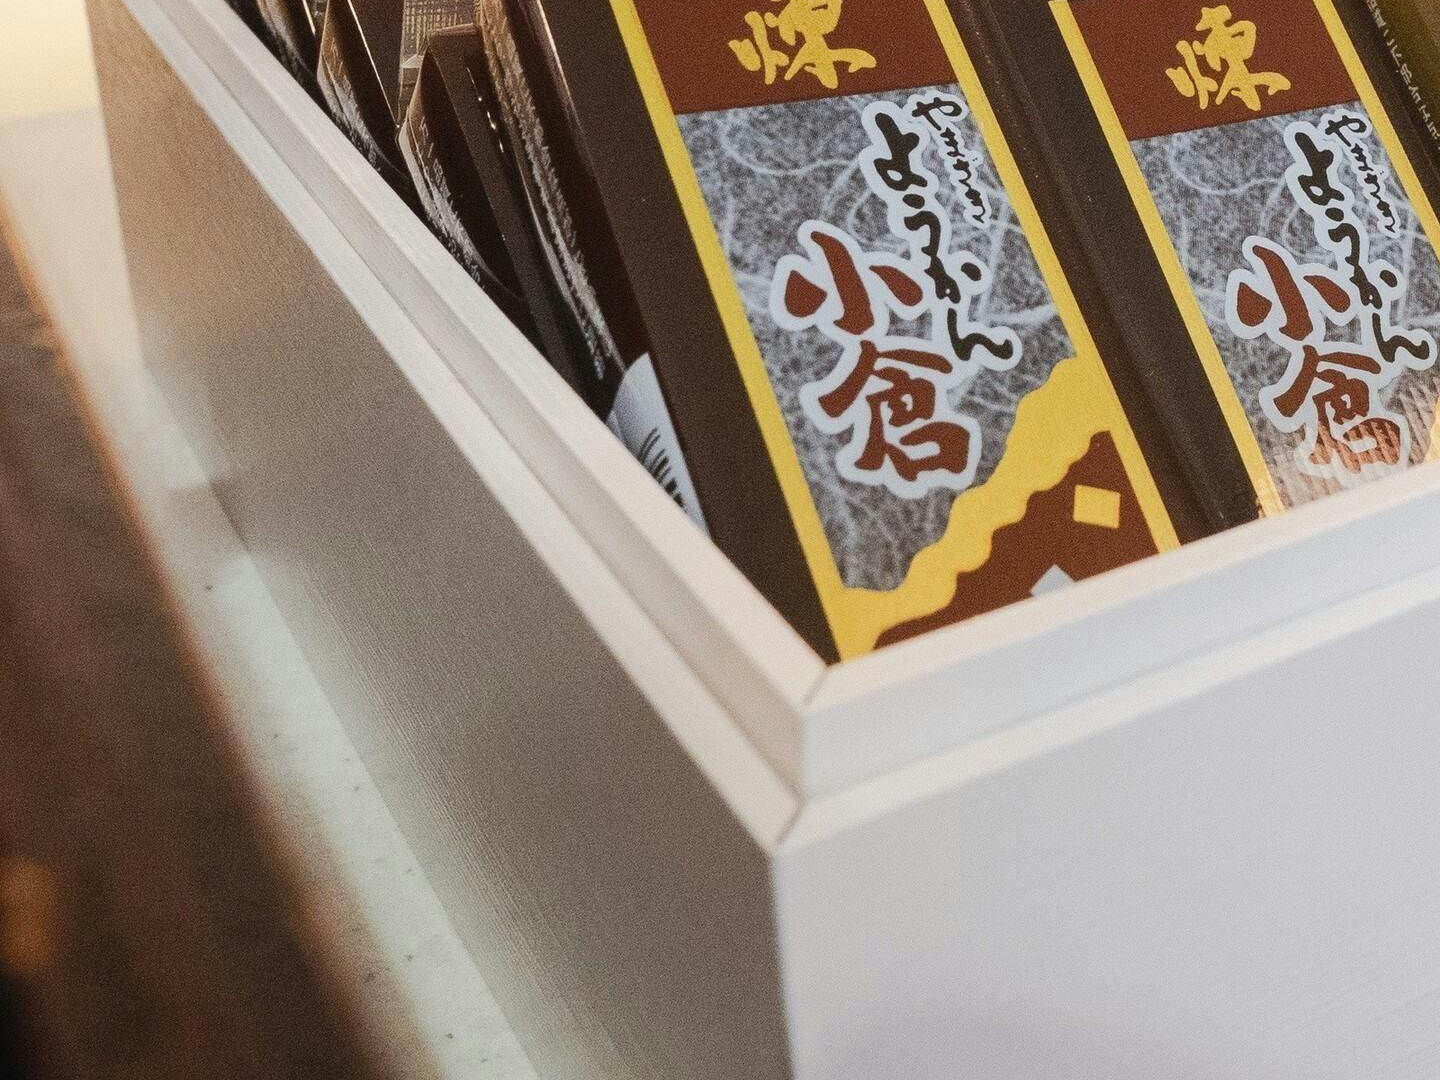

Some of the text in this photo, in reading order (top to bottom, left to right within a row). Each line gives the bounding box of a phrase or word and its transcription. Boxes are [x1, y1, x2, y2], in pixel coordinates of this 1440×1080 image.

[1166, 4, 1291, 112] 煉
[876, 112, 1014, 363] ようかん
[1286, 131, 1432, 363] ようかん
[782, 229, 970, 482] 小倉
[1236, 243, 1404, 475] 小倉
